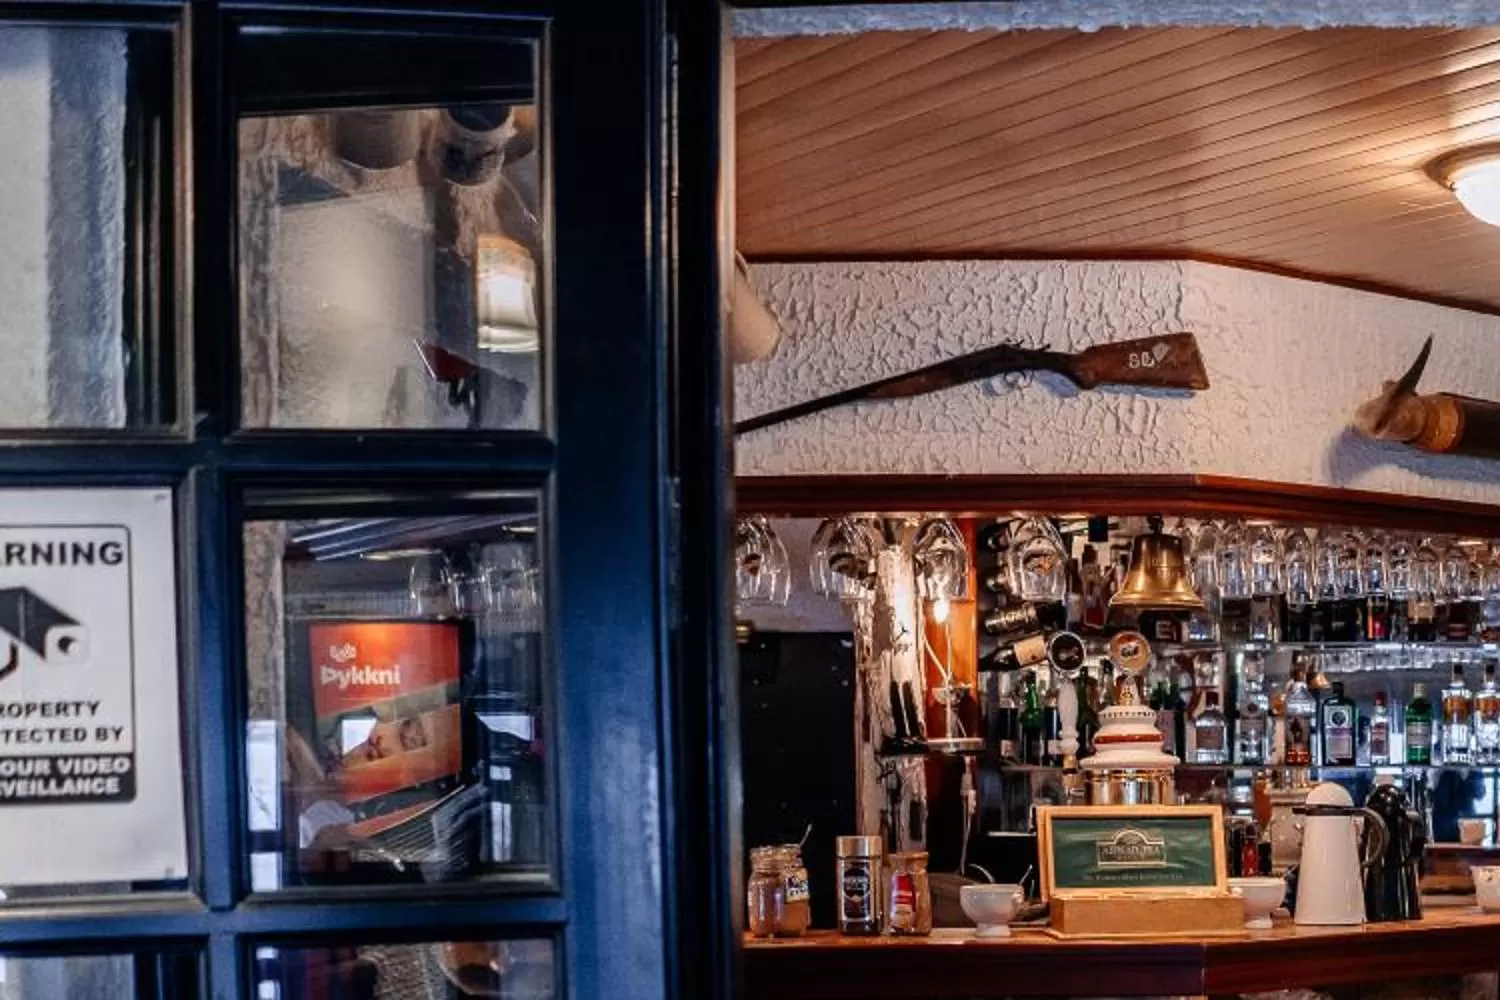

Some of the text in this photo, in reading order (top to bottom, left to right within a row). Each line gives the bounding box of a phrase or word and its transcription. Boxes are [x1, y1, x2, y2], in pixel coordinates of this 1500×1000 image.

[0, 542, 124, 566] RNING
[2, 726, 124, 744] TECTED BY
[0, 757, 131, 777] OUR VIDEO
[0, 776, 121, 798] VEILLANCE
